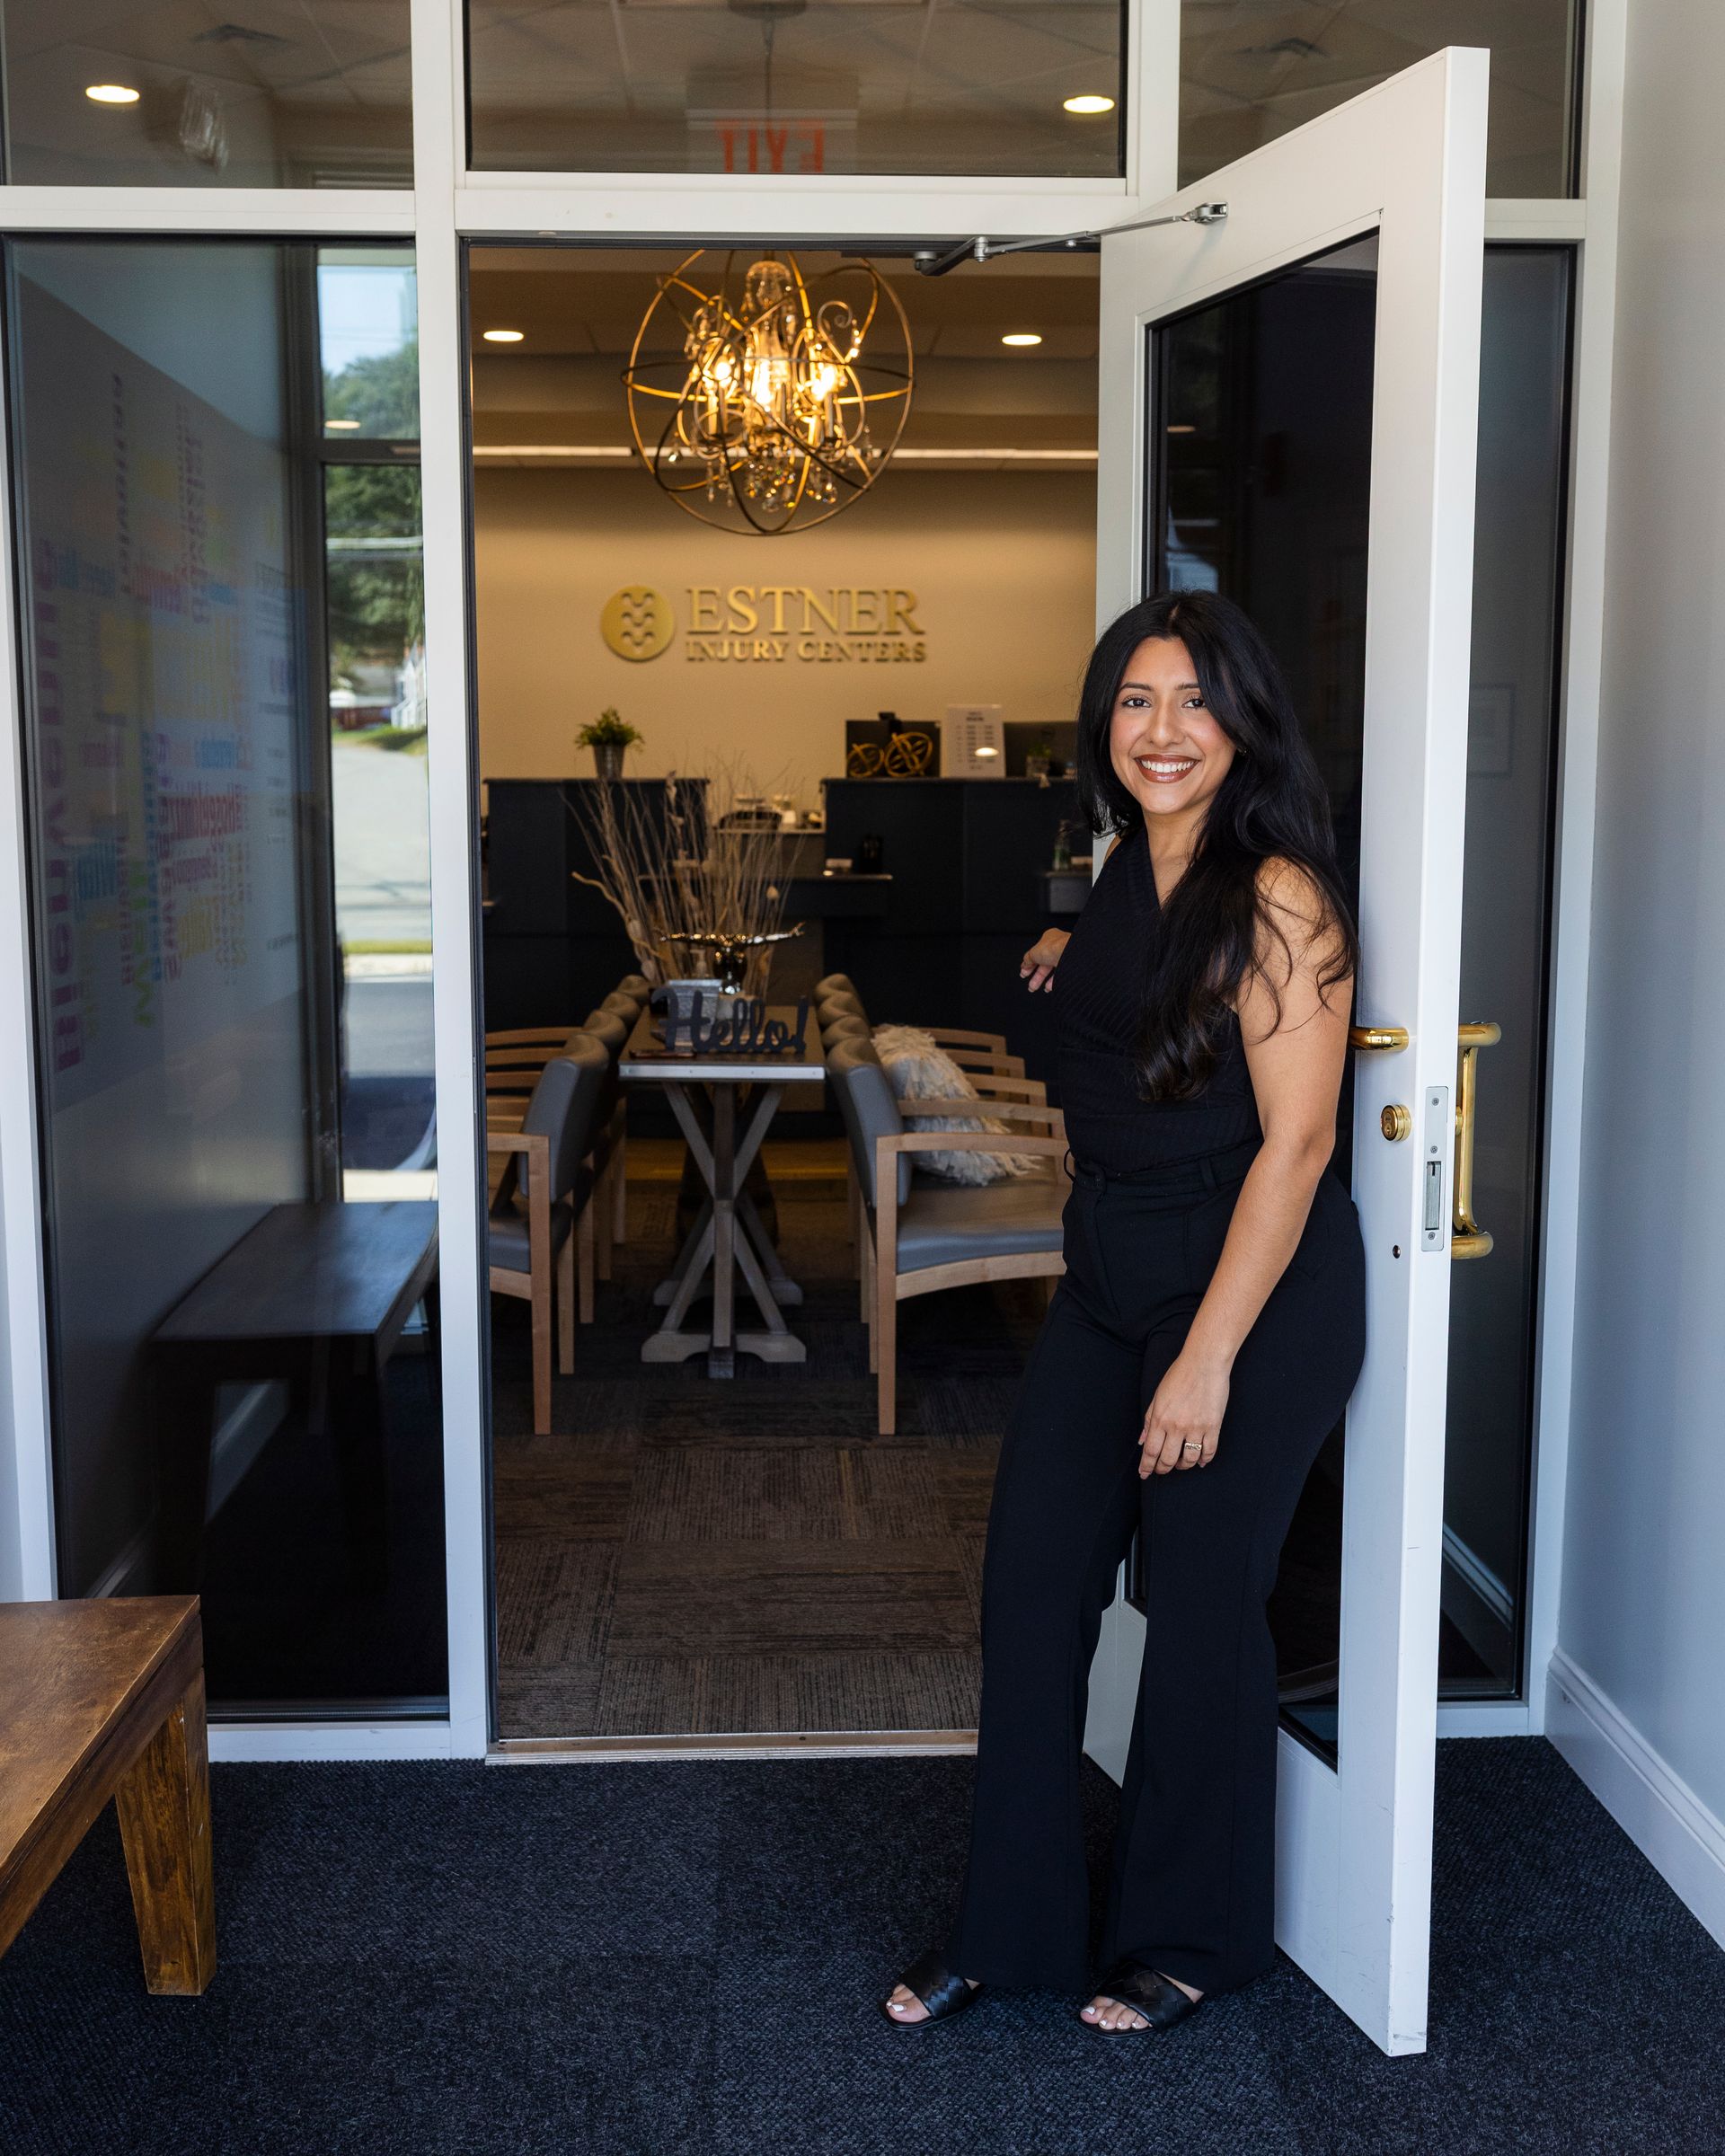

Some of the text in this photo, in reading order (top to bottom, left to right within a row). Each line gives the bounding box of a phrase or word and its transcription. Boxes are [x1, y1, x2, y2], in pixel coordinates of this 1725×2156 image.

[686, 587, 926, 636] ESTNER
[686, 639, 927, 664] INJURY CENTERS
[650, 985, 809, 1054] Hello!
